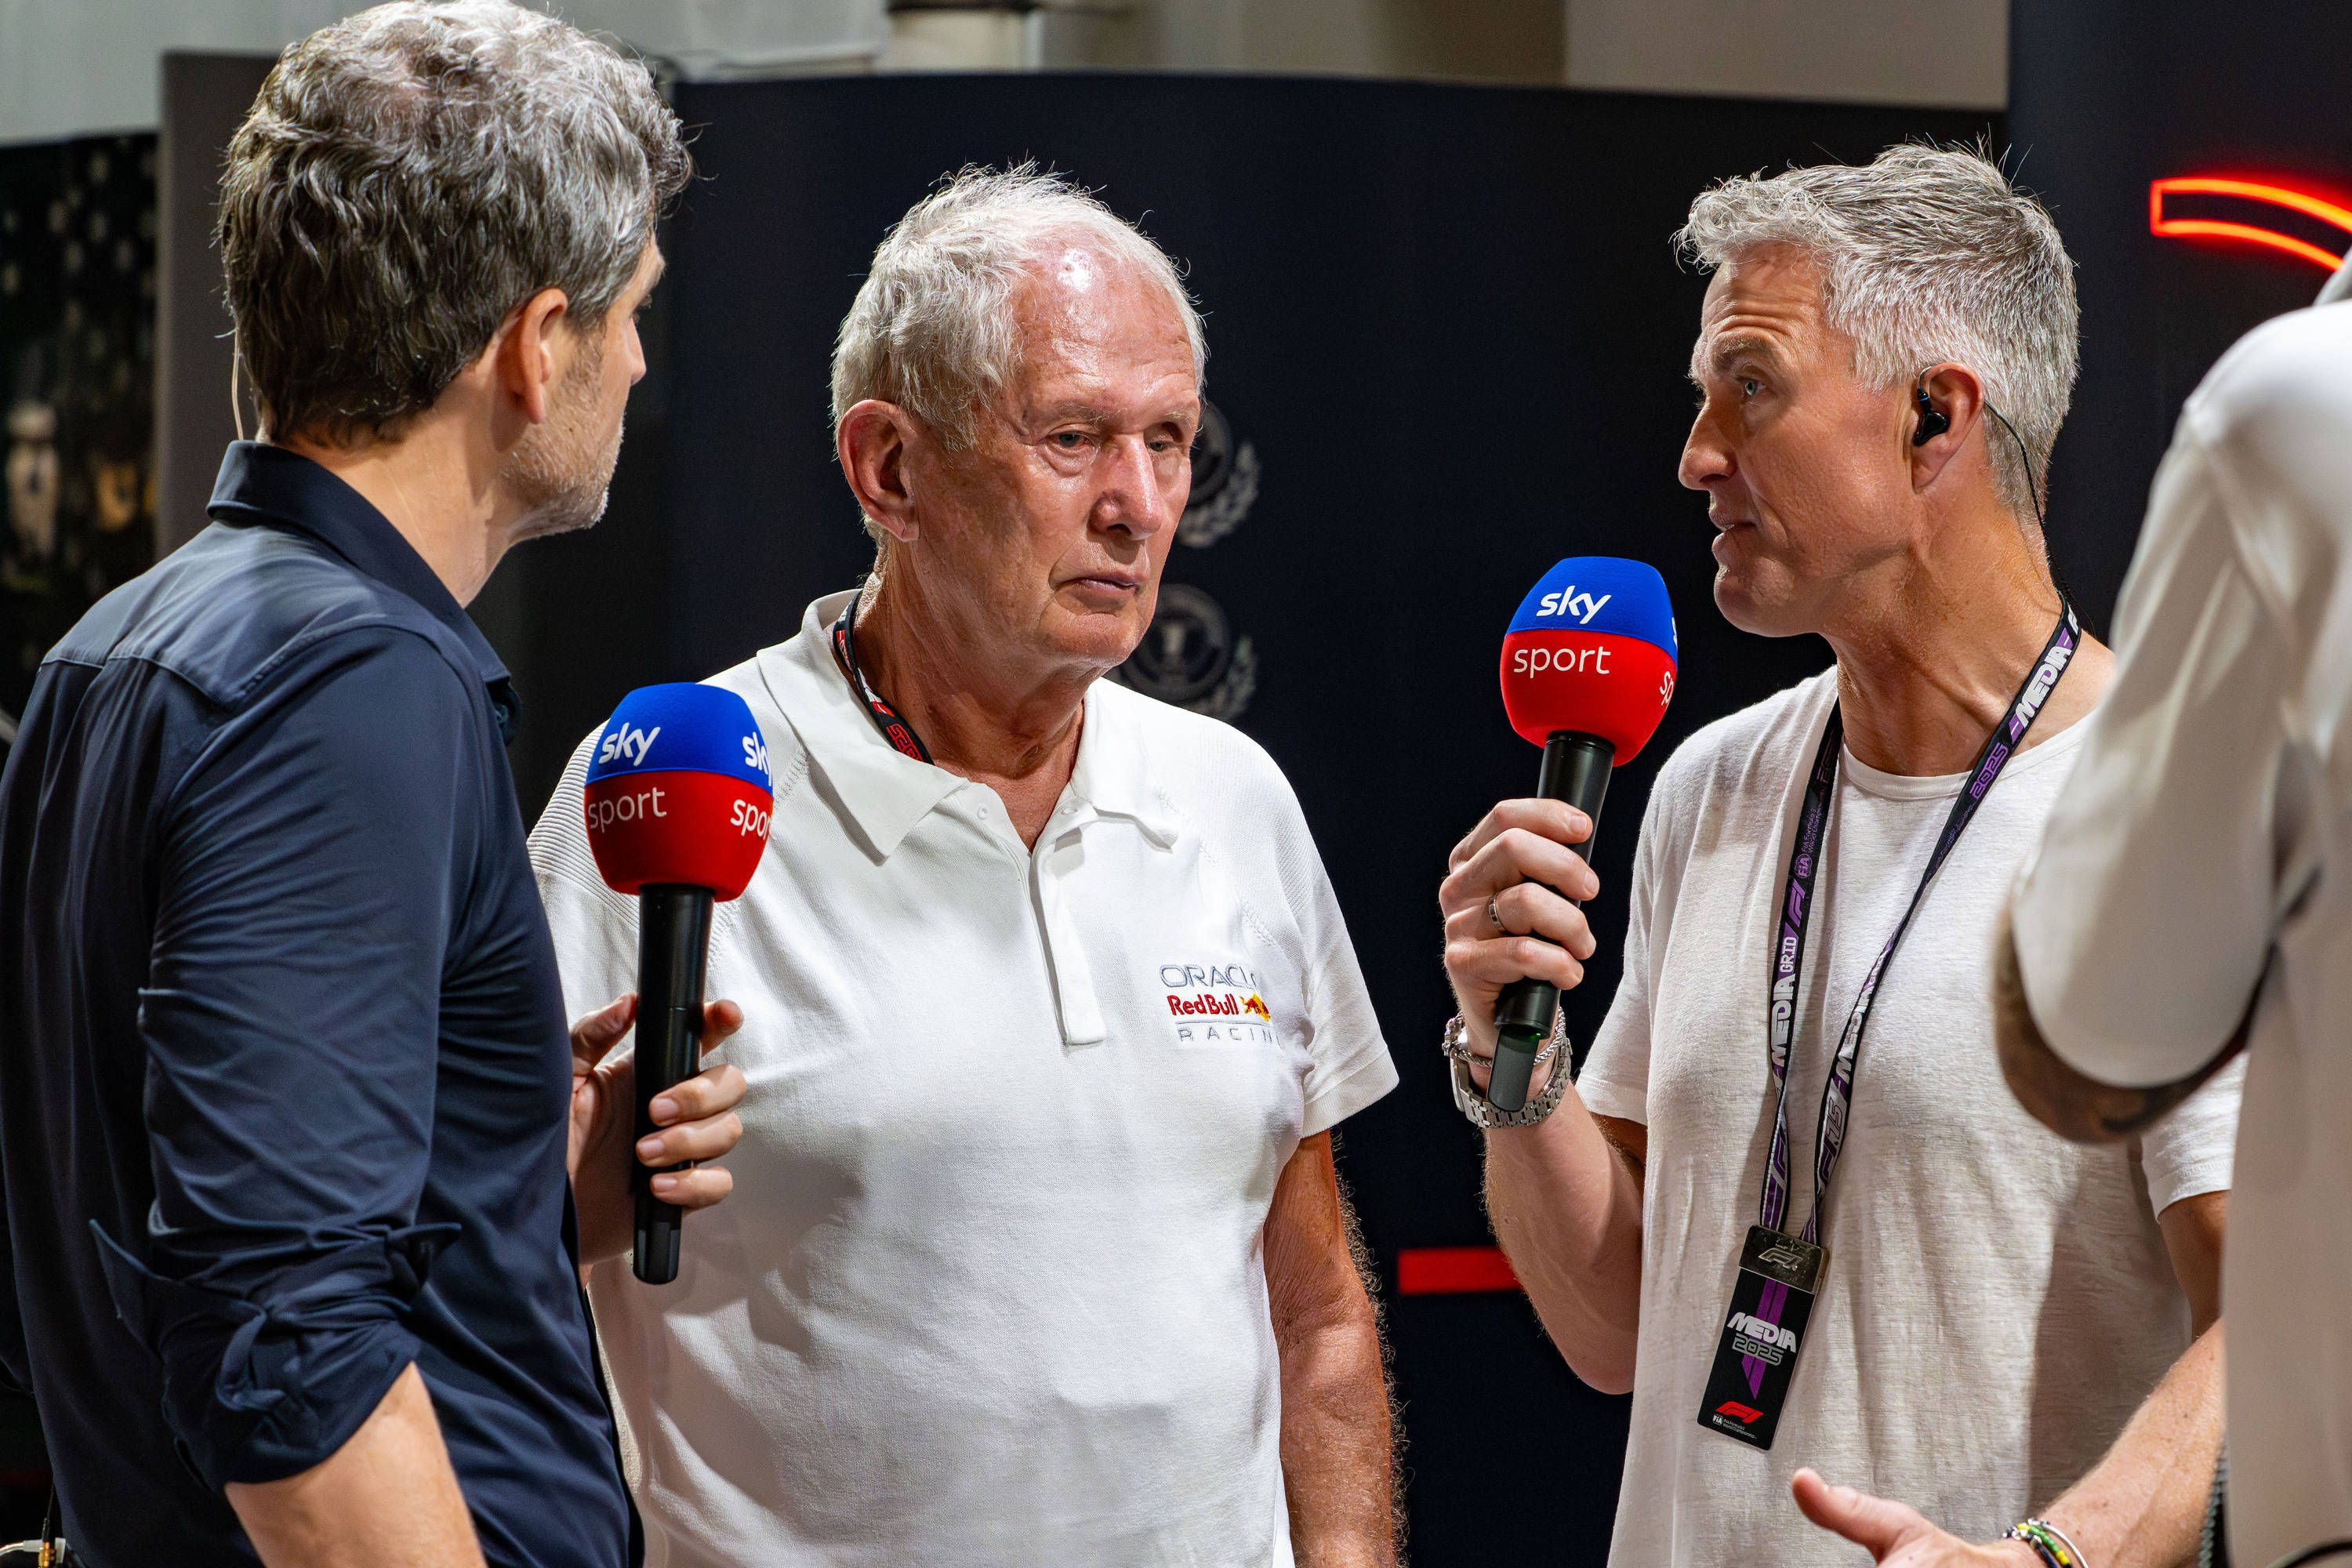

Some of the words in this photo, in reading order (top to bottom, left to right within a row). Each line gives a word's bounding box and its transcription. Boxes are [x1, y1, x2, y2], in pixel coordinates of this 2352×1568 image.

[1536, 585, 1612, 625] sky
[1513, 646, 1612, 679] sport
[2015, 645, 2073, 729] MEDIA
[598, 721, 661, 767] sky
[886, 723, 924, 762] 025
[1969, 742, 2009, 800] 2025
[587, 786, 667, 833] sport
[1780, 937, 1798, 973] GRID
[1160, 964, 1260, 991] ORACL
[1177, 1026, 1283, 1049] RACIN
[1771, 974, 1796, 1067] MEDIA
[1726, 1312, 1797, 1353] MEDIA
[1732, 1333, 1784, 1367] 2025
[1715, 1400, 1765, 1425] F1
